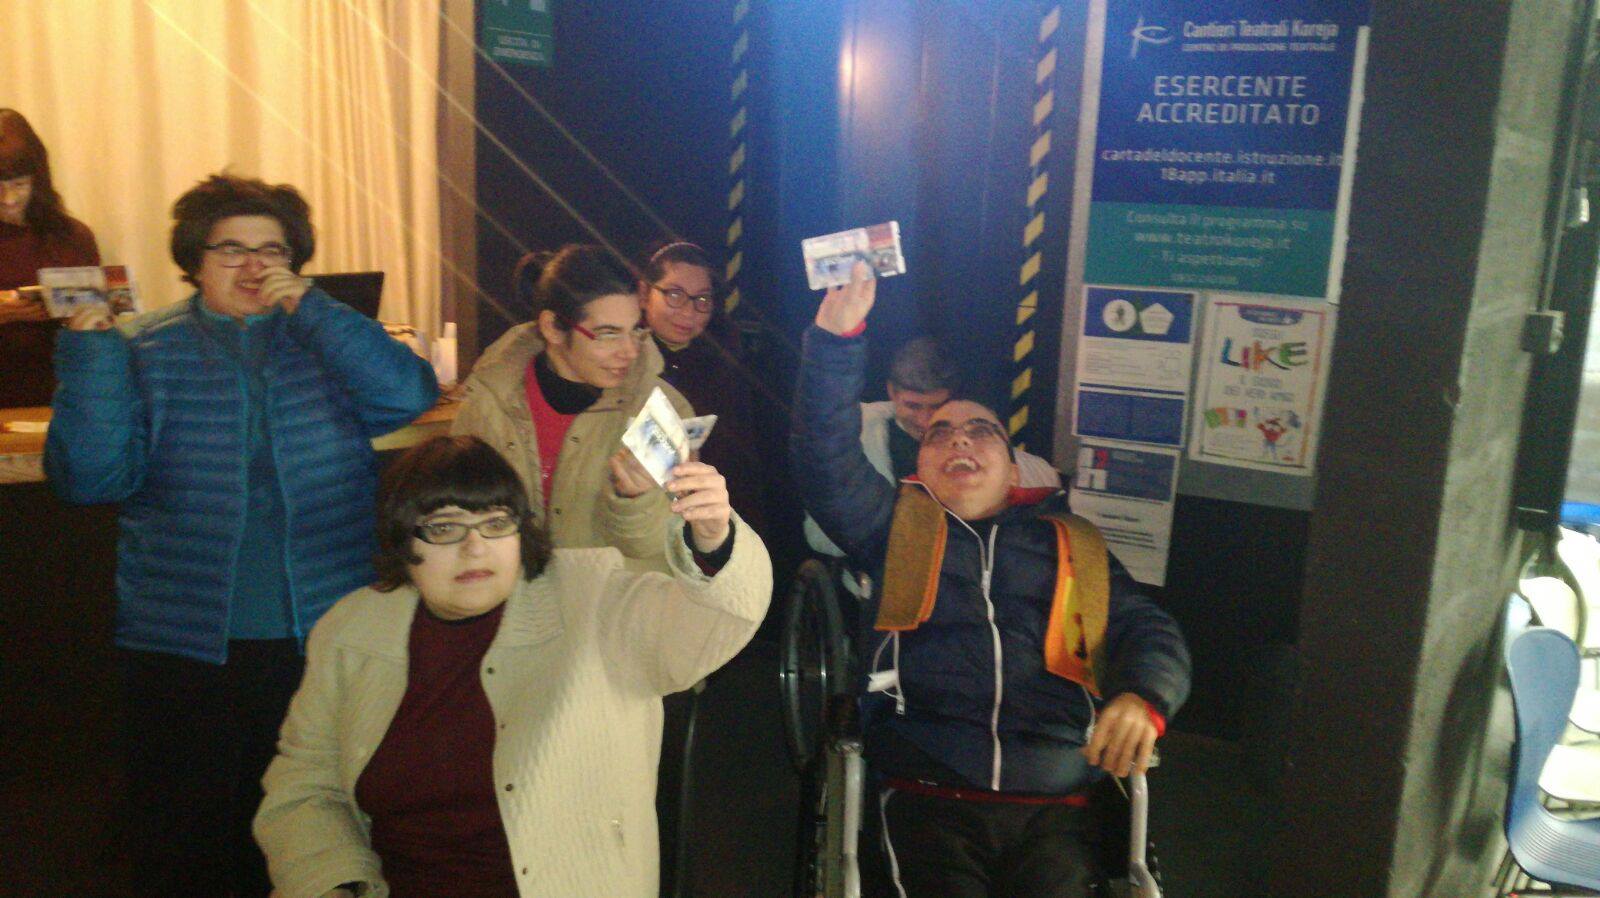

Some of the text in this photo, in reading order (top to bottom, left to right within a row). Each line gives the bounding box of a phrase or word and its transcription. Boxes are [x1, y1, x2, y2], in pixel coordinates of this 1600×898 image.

[1183, 19, 1339, 40] Cantieri Teatrali Koreja
[1154, 75, 1307, 97] ESERCENTE
[1136, 102, 1321, 125] ACCREDITATO
[1161, 167, 1276, 185] 18app.italia.it
[1203, 216, 1287, 232] programma
[1220, 336, 1309, 371] LIKE
